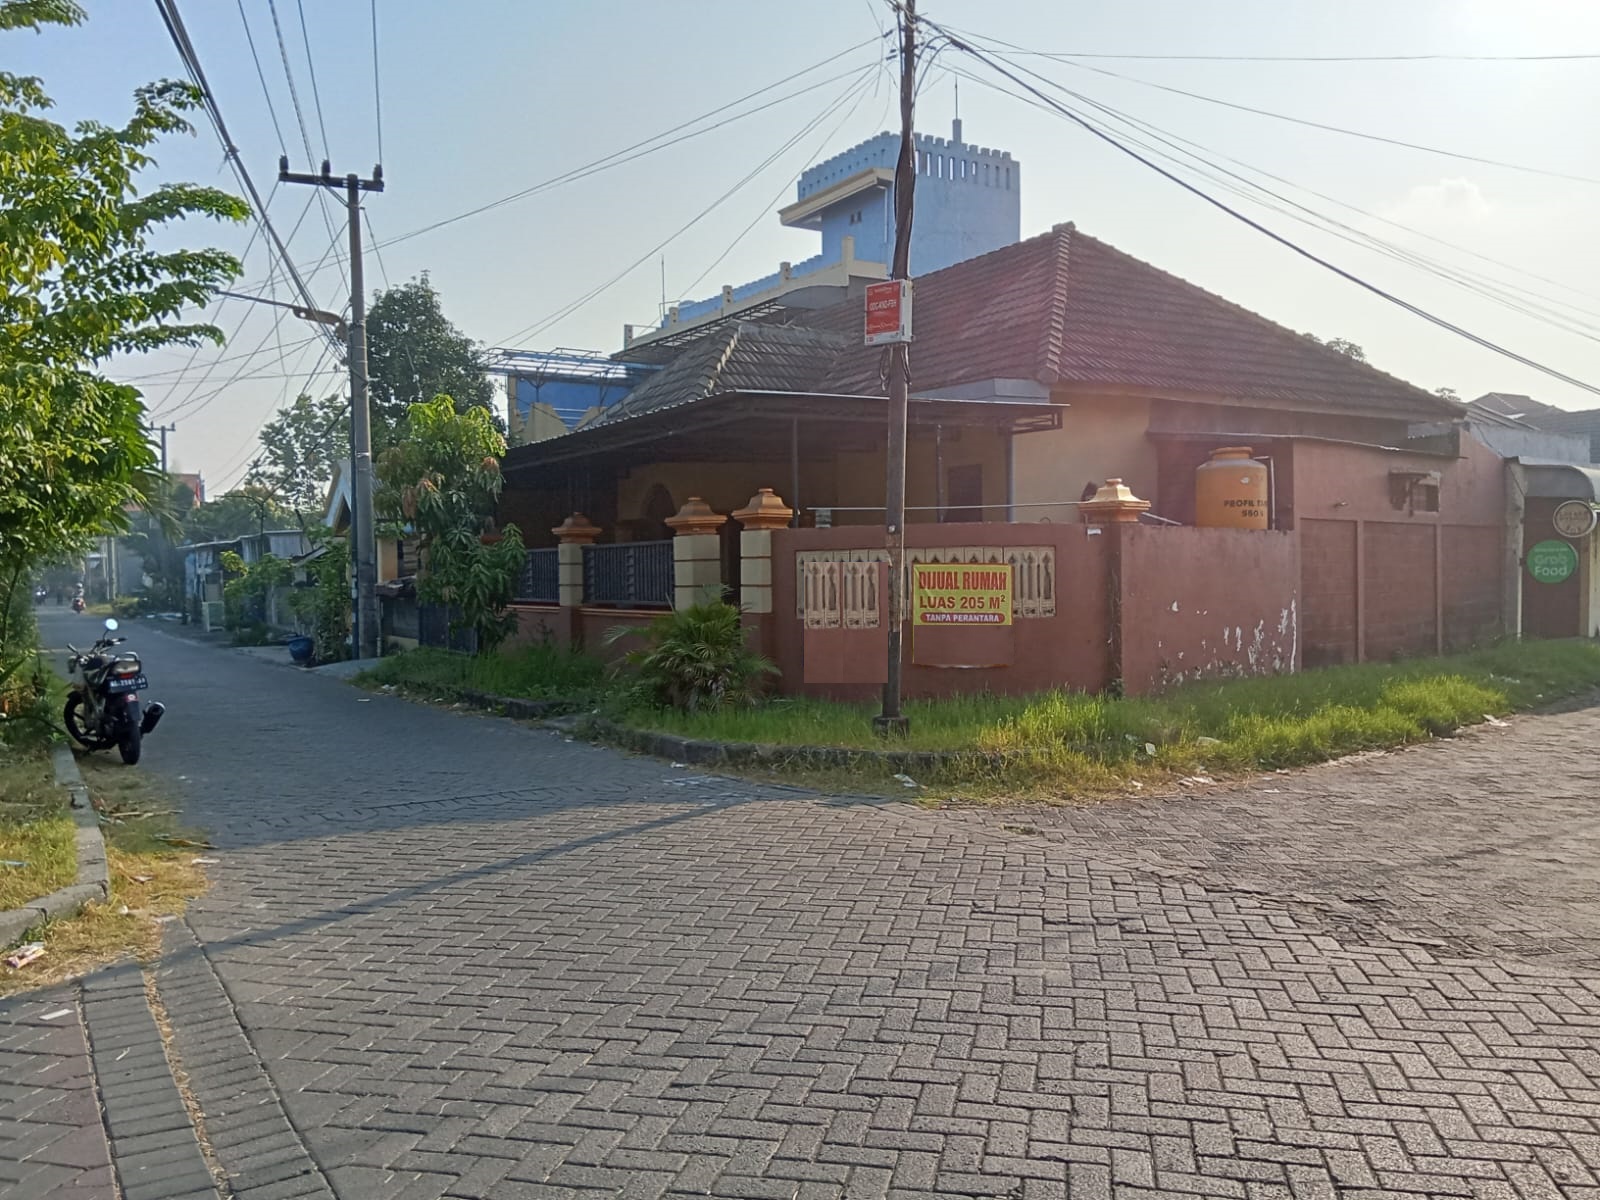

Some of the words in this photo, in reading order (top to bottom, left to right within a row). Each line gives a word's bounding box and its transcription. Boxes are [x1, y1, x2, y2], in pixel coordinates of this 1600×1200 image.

[1534, 552, 1568, 565] Grab
[1534, 565, 1568, 576] Food
[918, 571, 960, 590] DIJUAL
[962, 571, 1007, 591] RUMAH
[919, 595, 956, 609] LUAS
[959, 596, 985, 609] 205
[926, 613, 952, 622] TANPA
[953, 613, 1000, 623] PERANTARA
